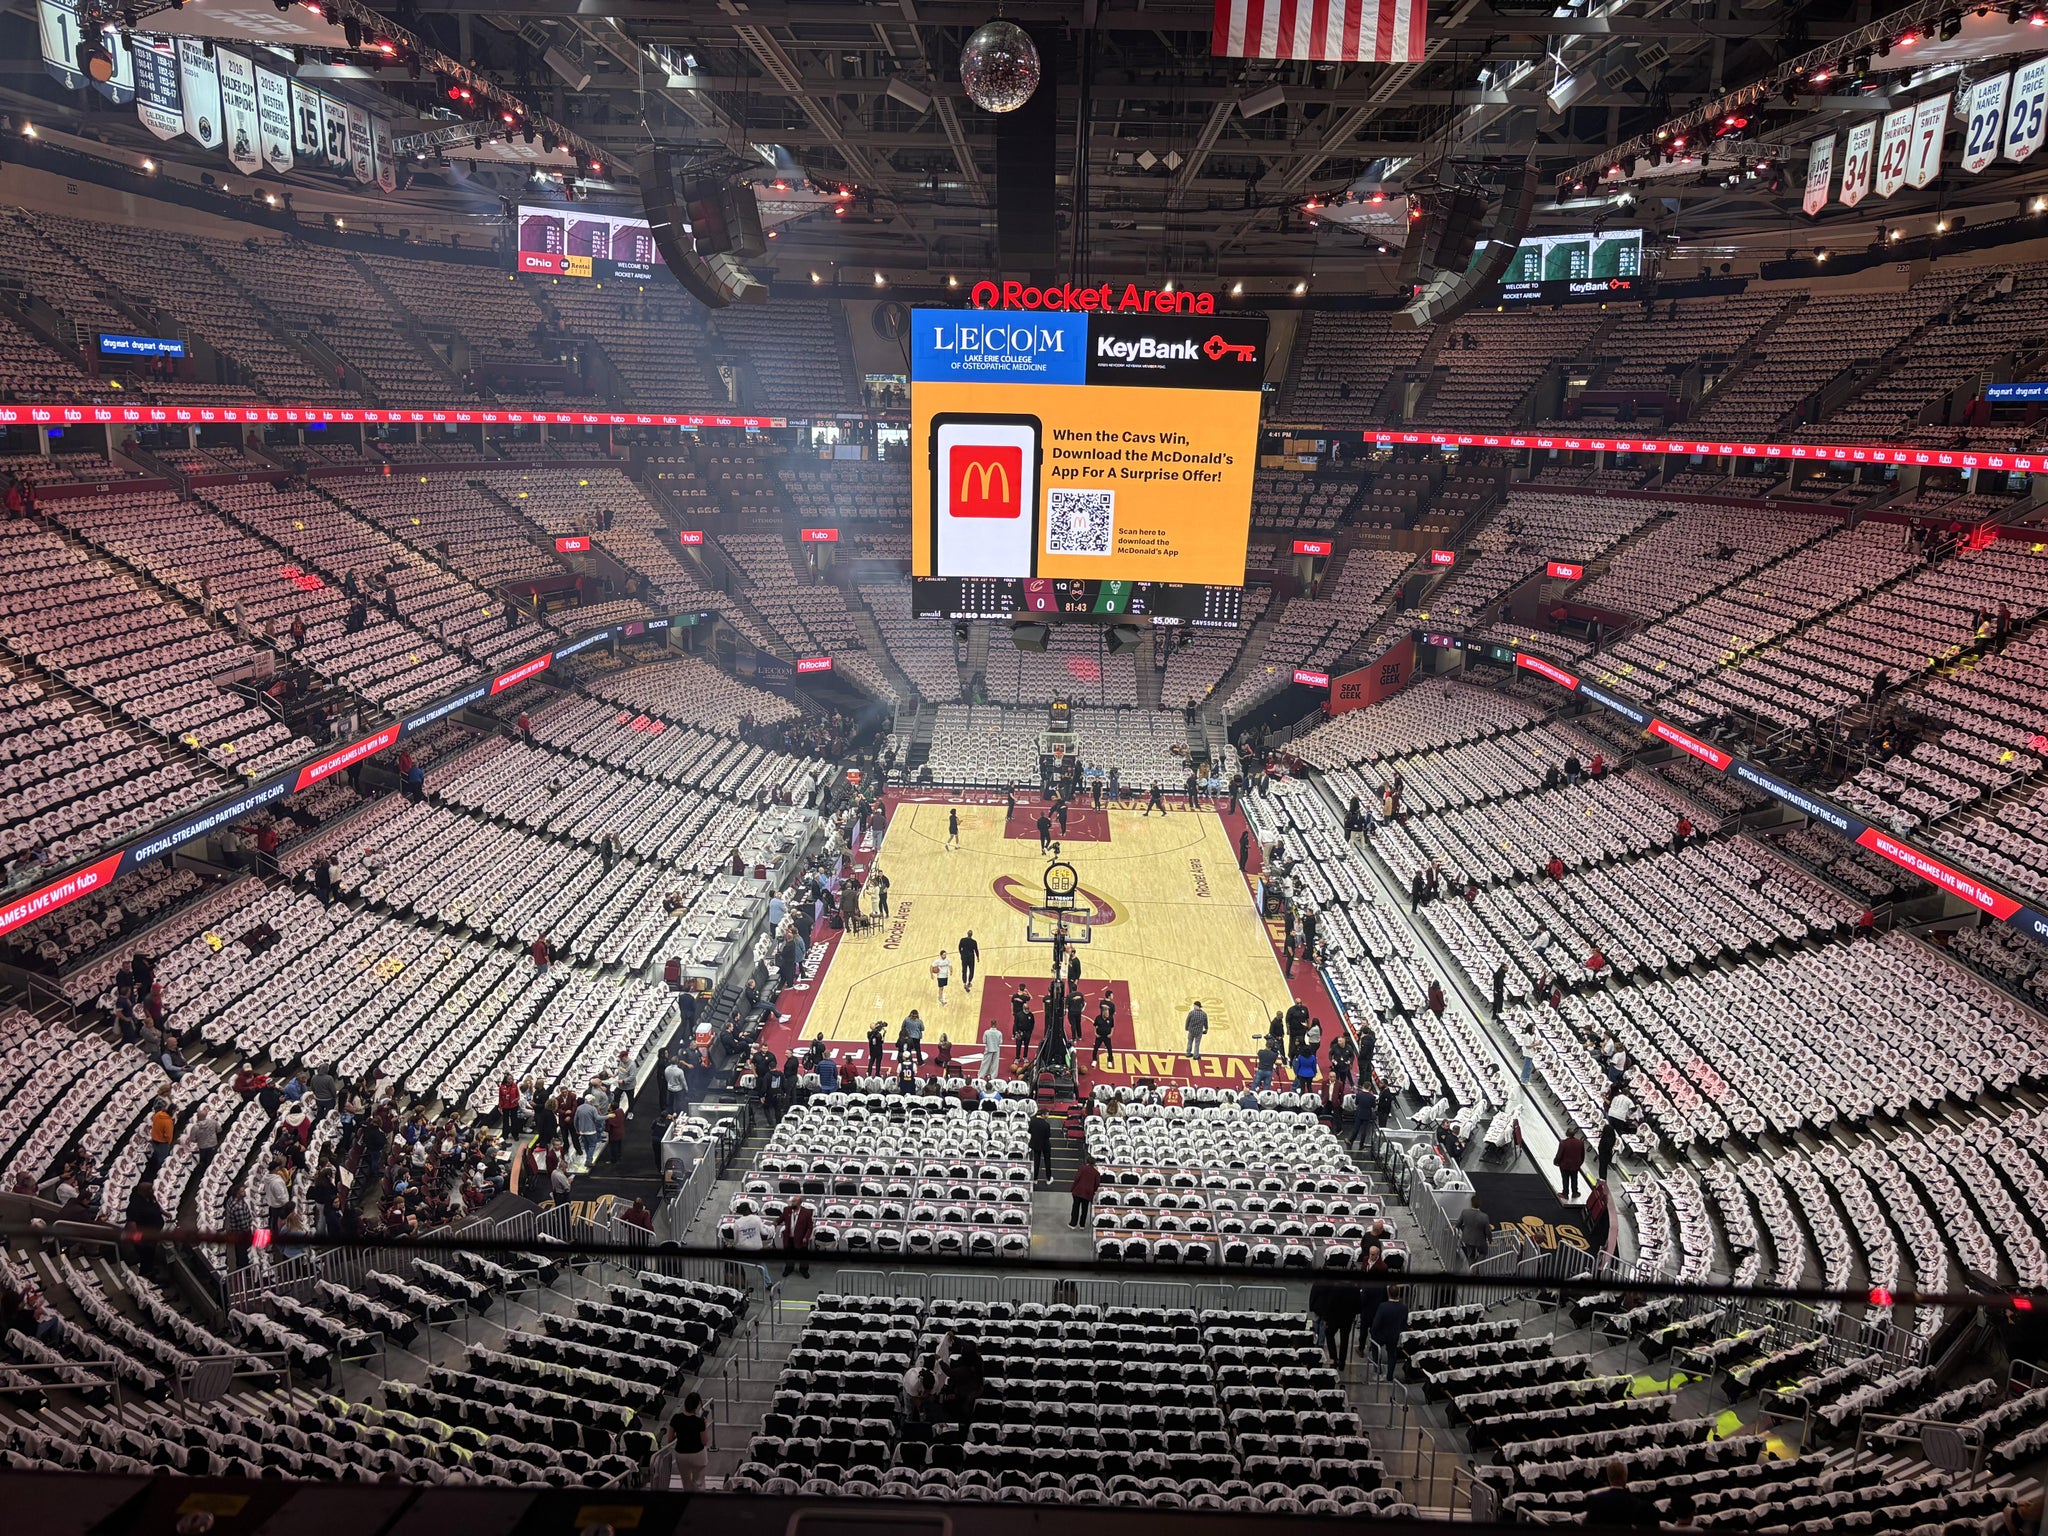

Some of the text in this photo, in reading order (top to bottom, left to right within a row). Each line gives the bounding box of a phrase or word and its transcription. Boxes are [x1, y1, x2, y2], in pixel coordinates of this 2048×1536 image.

[57, 13, 71, 63] 1
[228, 60, 243, 76] 2016
[2023, 65, 2047, 83] MARK
[260, 77, 284, 95] 2015-16
[1978, 81, 2002, 99] LARRY
[2021, 78, 2045, 96] PRICE
[263, 94, 285, 112] WESTERN
[1976, 93, 2000, 111] NANCE
[299, 106, 319, 148] 15
[1891, 114, 1907, 128] NATE
[1921, 114, 1940, 128] SMITH
[2009, 93, 2045, 145] 25
[327, 118, 346, 160] 27
[1968, 109, 1999, 157] 22
[1853, 139, 1868, 151] CARR
[1920, 129, 1934, 169] 7
[1816, 156, 1830, 173] JOE
[1880, 139, 1907, 180] 42
[1813, 171, 1829, 187] TAIT
[1845, 151, 1869, 191] 34
[526, 257, 590, 271] Ohio Rental
[617, 262, 640, 270] WELCOME
[614, 271, 633, 279] ROCKET
[1569, 282, 1608, 293] KeyBank
[1003, 280, 1215, 315] Rocket Arena
[1097, 336, 1199, 362] KeyBank
[951, 362, 1047, 372] OF OSTEOPATHIC MEDICINE
[964, 354, 1032, 364] LAKE ERIE COLLEGE
[95, 409, 112, 420] fubo
[176, 409, 191, 420] fubo
[246, 410, 258, 420] fubo
[305, 411, 316, 420] fubo
[364, 412, 378, 421] fubo
[433, 412, 446, 421] fubo
[508, 413, 522, 422] fubo
[583, 415, 598, 423] fubo
[689, 417, 704, 425] fubo
[1052, 429, 1190, 446] When the Cavs Win,
[1052, 447, 1234, 465] Download the McDonald's
[1458, 436, 1473, 444] fubo
[1537, 439, 1553, 447] fubo
[1616, 442, 1631, 450] fubo
[1696, 444, 1710, 453] fubo
[1766, 446, 1781, 455] fubo
[1834, 449, 1846, 458] fubo
[1894, 451, 1907, 462] fubo
[1963, 455, 1977, 466] fubo
[1051, 465, 1222, 483] App For A Surprise Offer!
[683, 533, 700, 542] fubo
[811, 531, 828, 539] fubo
[1118, 528, 1166, 537] Scan here to
[565, 540, 581, 549] fubo
[1118, 537, 1170, 547] download the
[1303, 543, 1321, 553] fubo
[1117, 547, 1179, 558] McDonald's App
[1434, 552, 1451, 563] fubo
[1556, 566, 1572, 577] fubo
[1056, 583, 1067, 591] 1Q
[1036, 598, 1045, 609] 0
[1065, 603, 1087, 612] 81:43
[1106, 601, 1114, 611] 0
[649, 620, 668, 629] BLOCKS
[1443, 638, 1448, 646] 0
[805, 660, 830, 669] Rocket
[1382, 663, 1400, 675] SEAT
[1302, 674, 1327, 684] Rocket
[1380, 674, 1400, 685] GEEK
[407, 687, 486, 731] OFFICIAL STREAMING PARTNER OF THE CAVS
[310, 734, 389, 778] WATCH CAVS GAMES LIVE WITH fubo
[1737, 766, 1848, 830] OFFICIAL STREAMING PARTNER OF THE CAVS
[135, 783, 285, 862] OFFICIAL STREAMING PARTNER OF THE CAVS
[1876, 838, 1994, 907] WATCH CAVS GAMES LIVE WITH fubo
[27, 893, 50, 914] LIVE
[49, 881, 76, 903] WITH
[76, 873, 98, 890] fubo
[902, 1069, 912, 1077] 10
